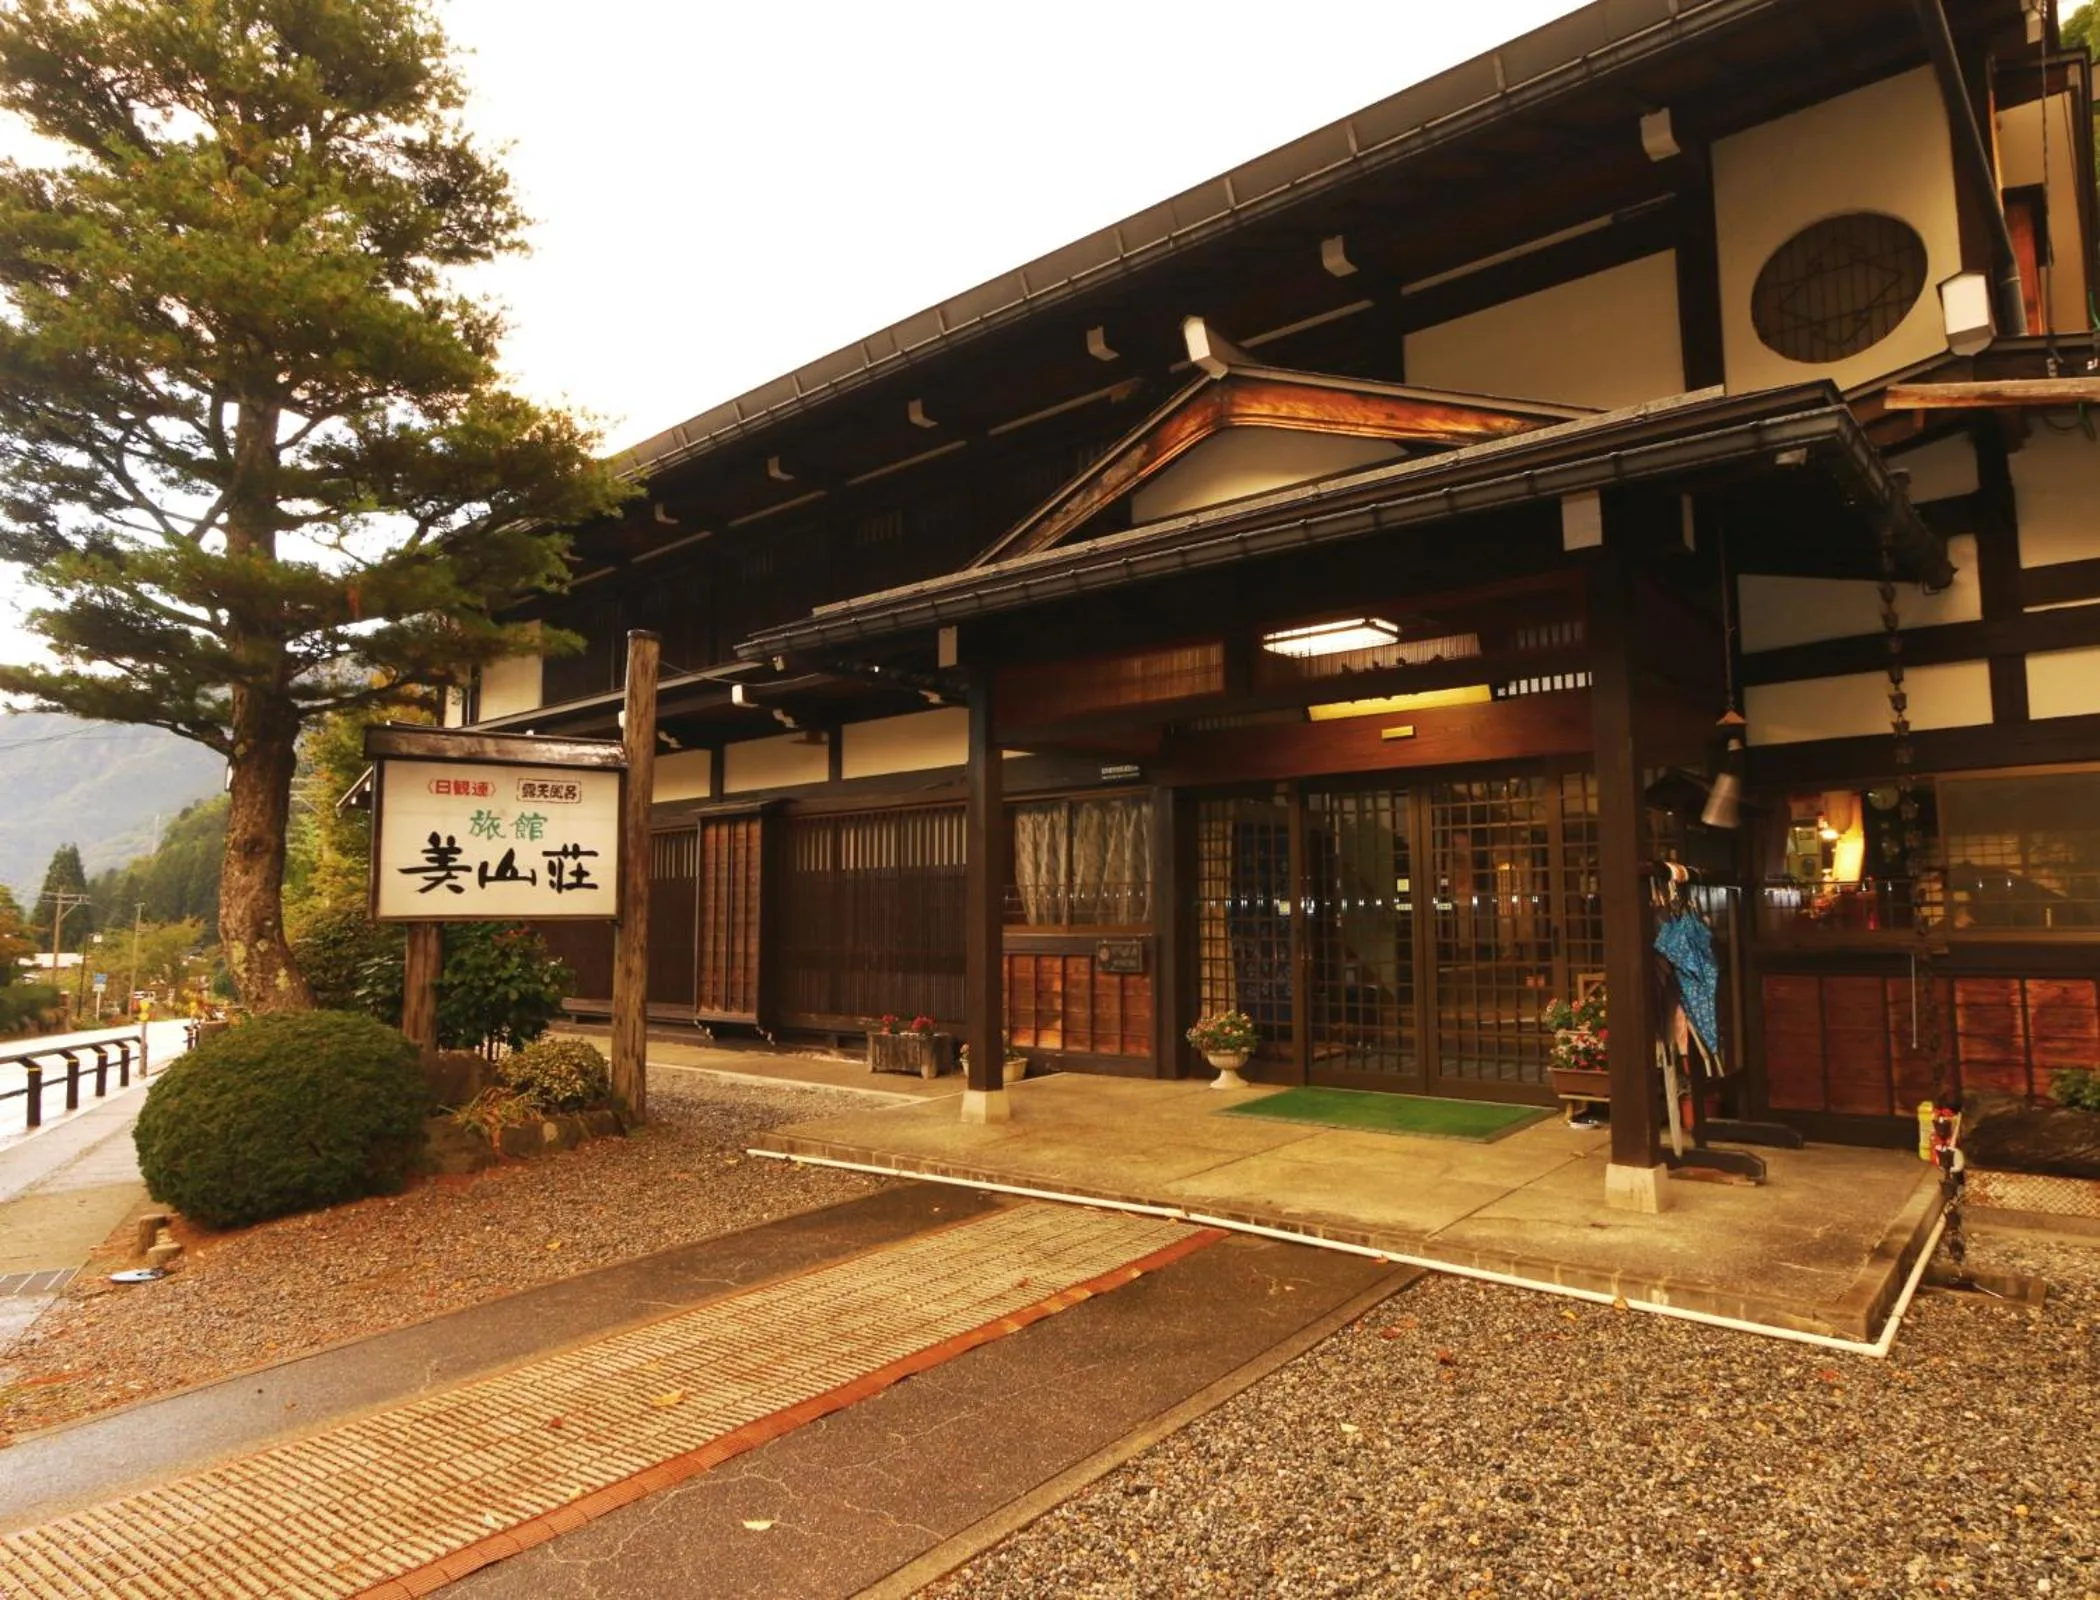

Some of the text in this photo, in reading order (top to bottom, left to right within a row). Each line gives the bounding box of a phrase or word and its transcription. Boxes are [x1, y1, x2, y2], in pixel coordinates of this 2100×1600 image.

[521, 783, 577, 800] 露天風呂
[468, 809, 548, 841] 旅館
[398, 831, 599, 894] 美山荘
